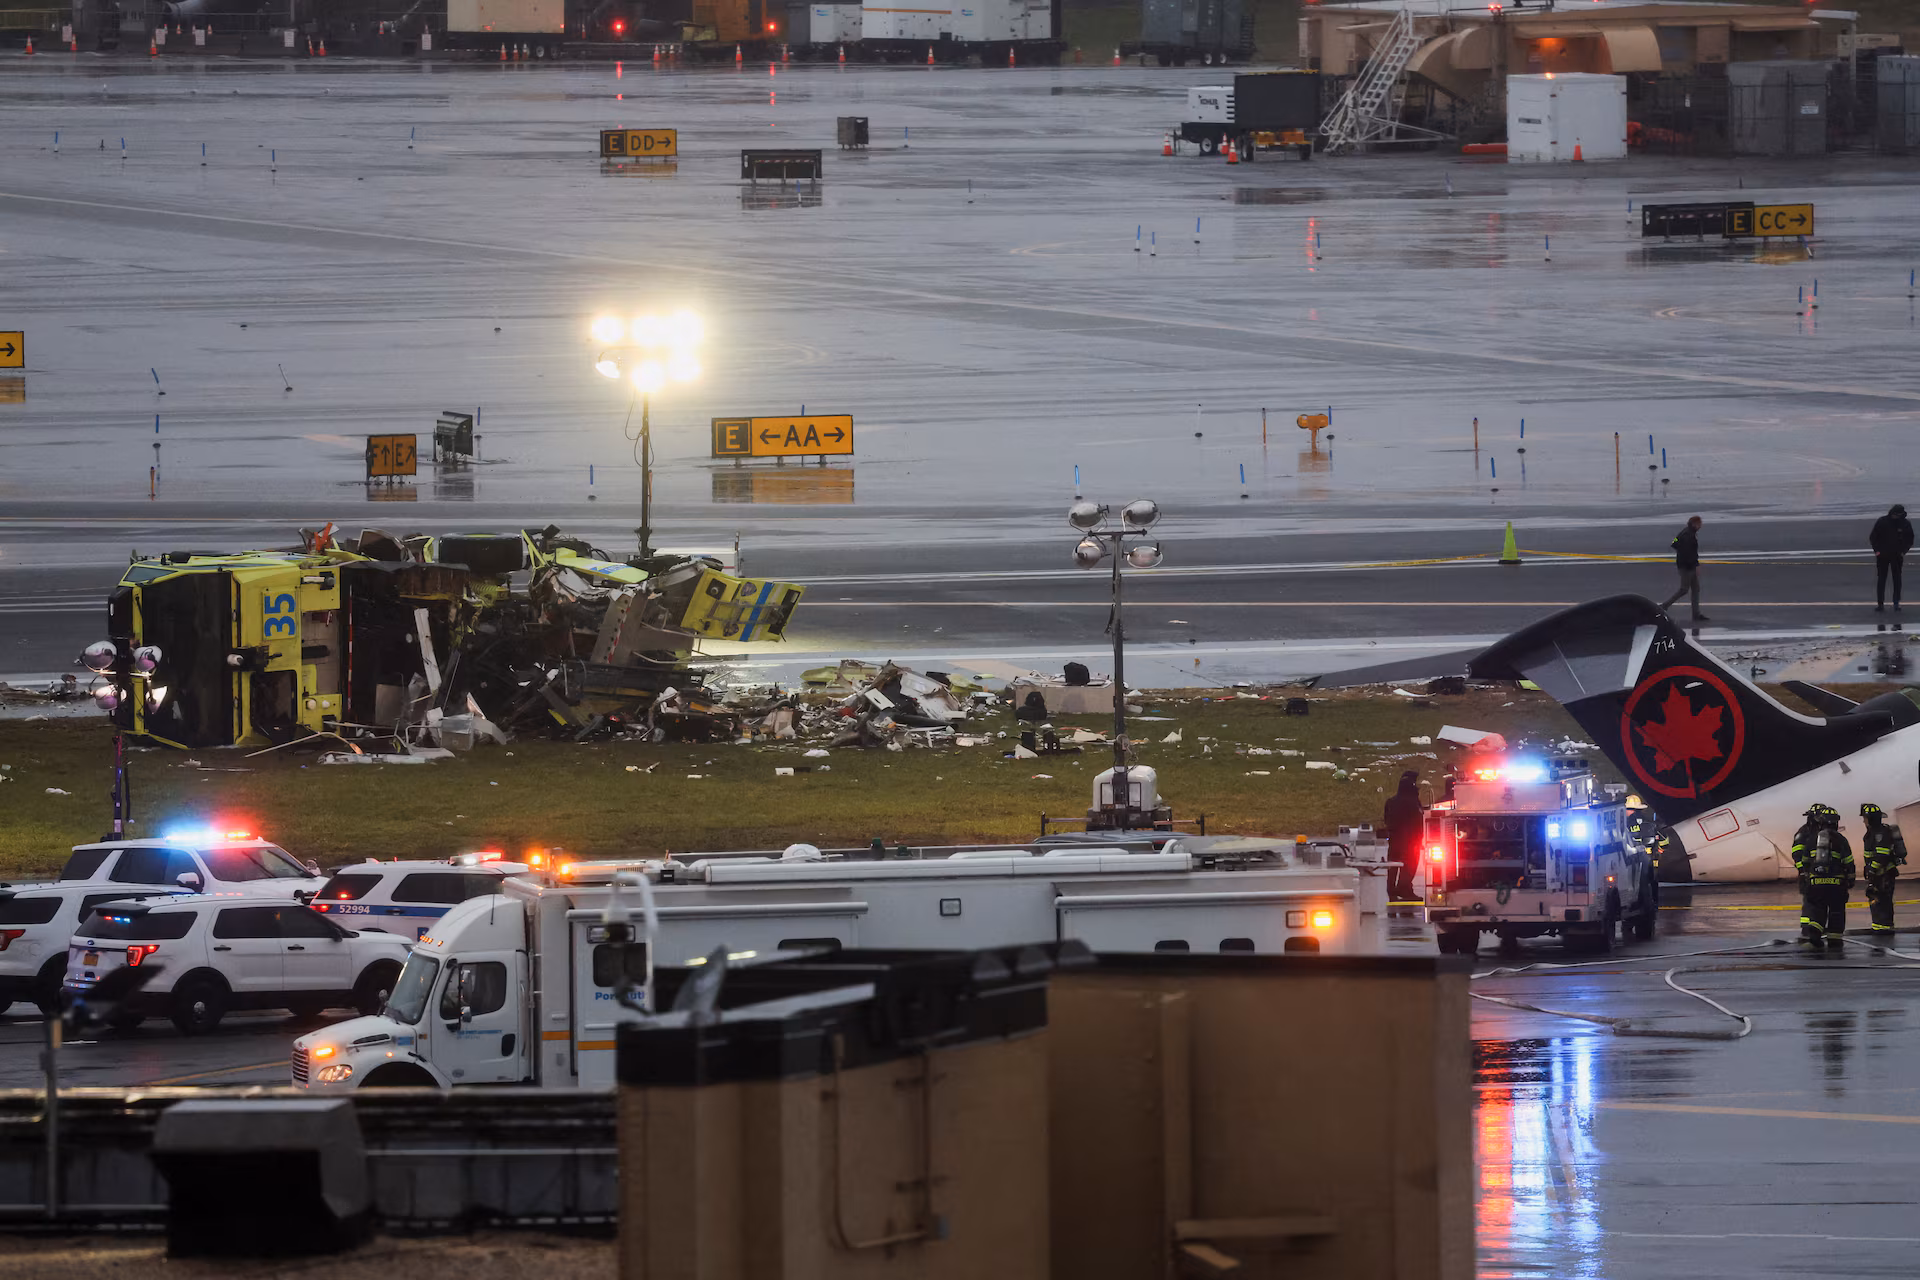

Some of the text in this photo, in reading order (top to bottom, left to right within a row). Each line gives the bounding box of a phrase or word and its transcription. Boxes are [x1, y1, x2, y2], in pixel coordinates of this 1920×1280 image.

[610, 135, 655, 151] E DD
[1734, 211, 1786, 231] E CC
[726, 424, 821, 449] E AA
[395, 443, 405, 467] E
[264, 593, 296, 637] 35
[1653, 638, 1676, 654] 714
[339, 904, 371, 914] 52994
